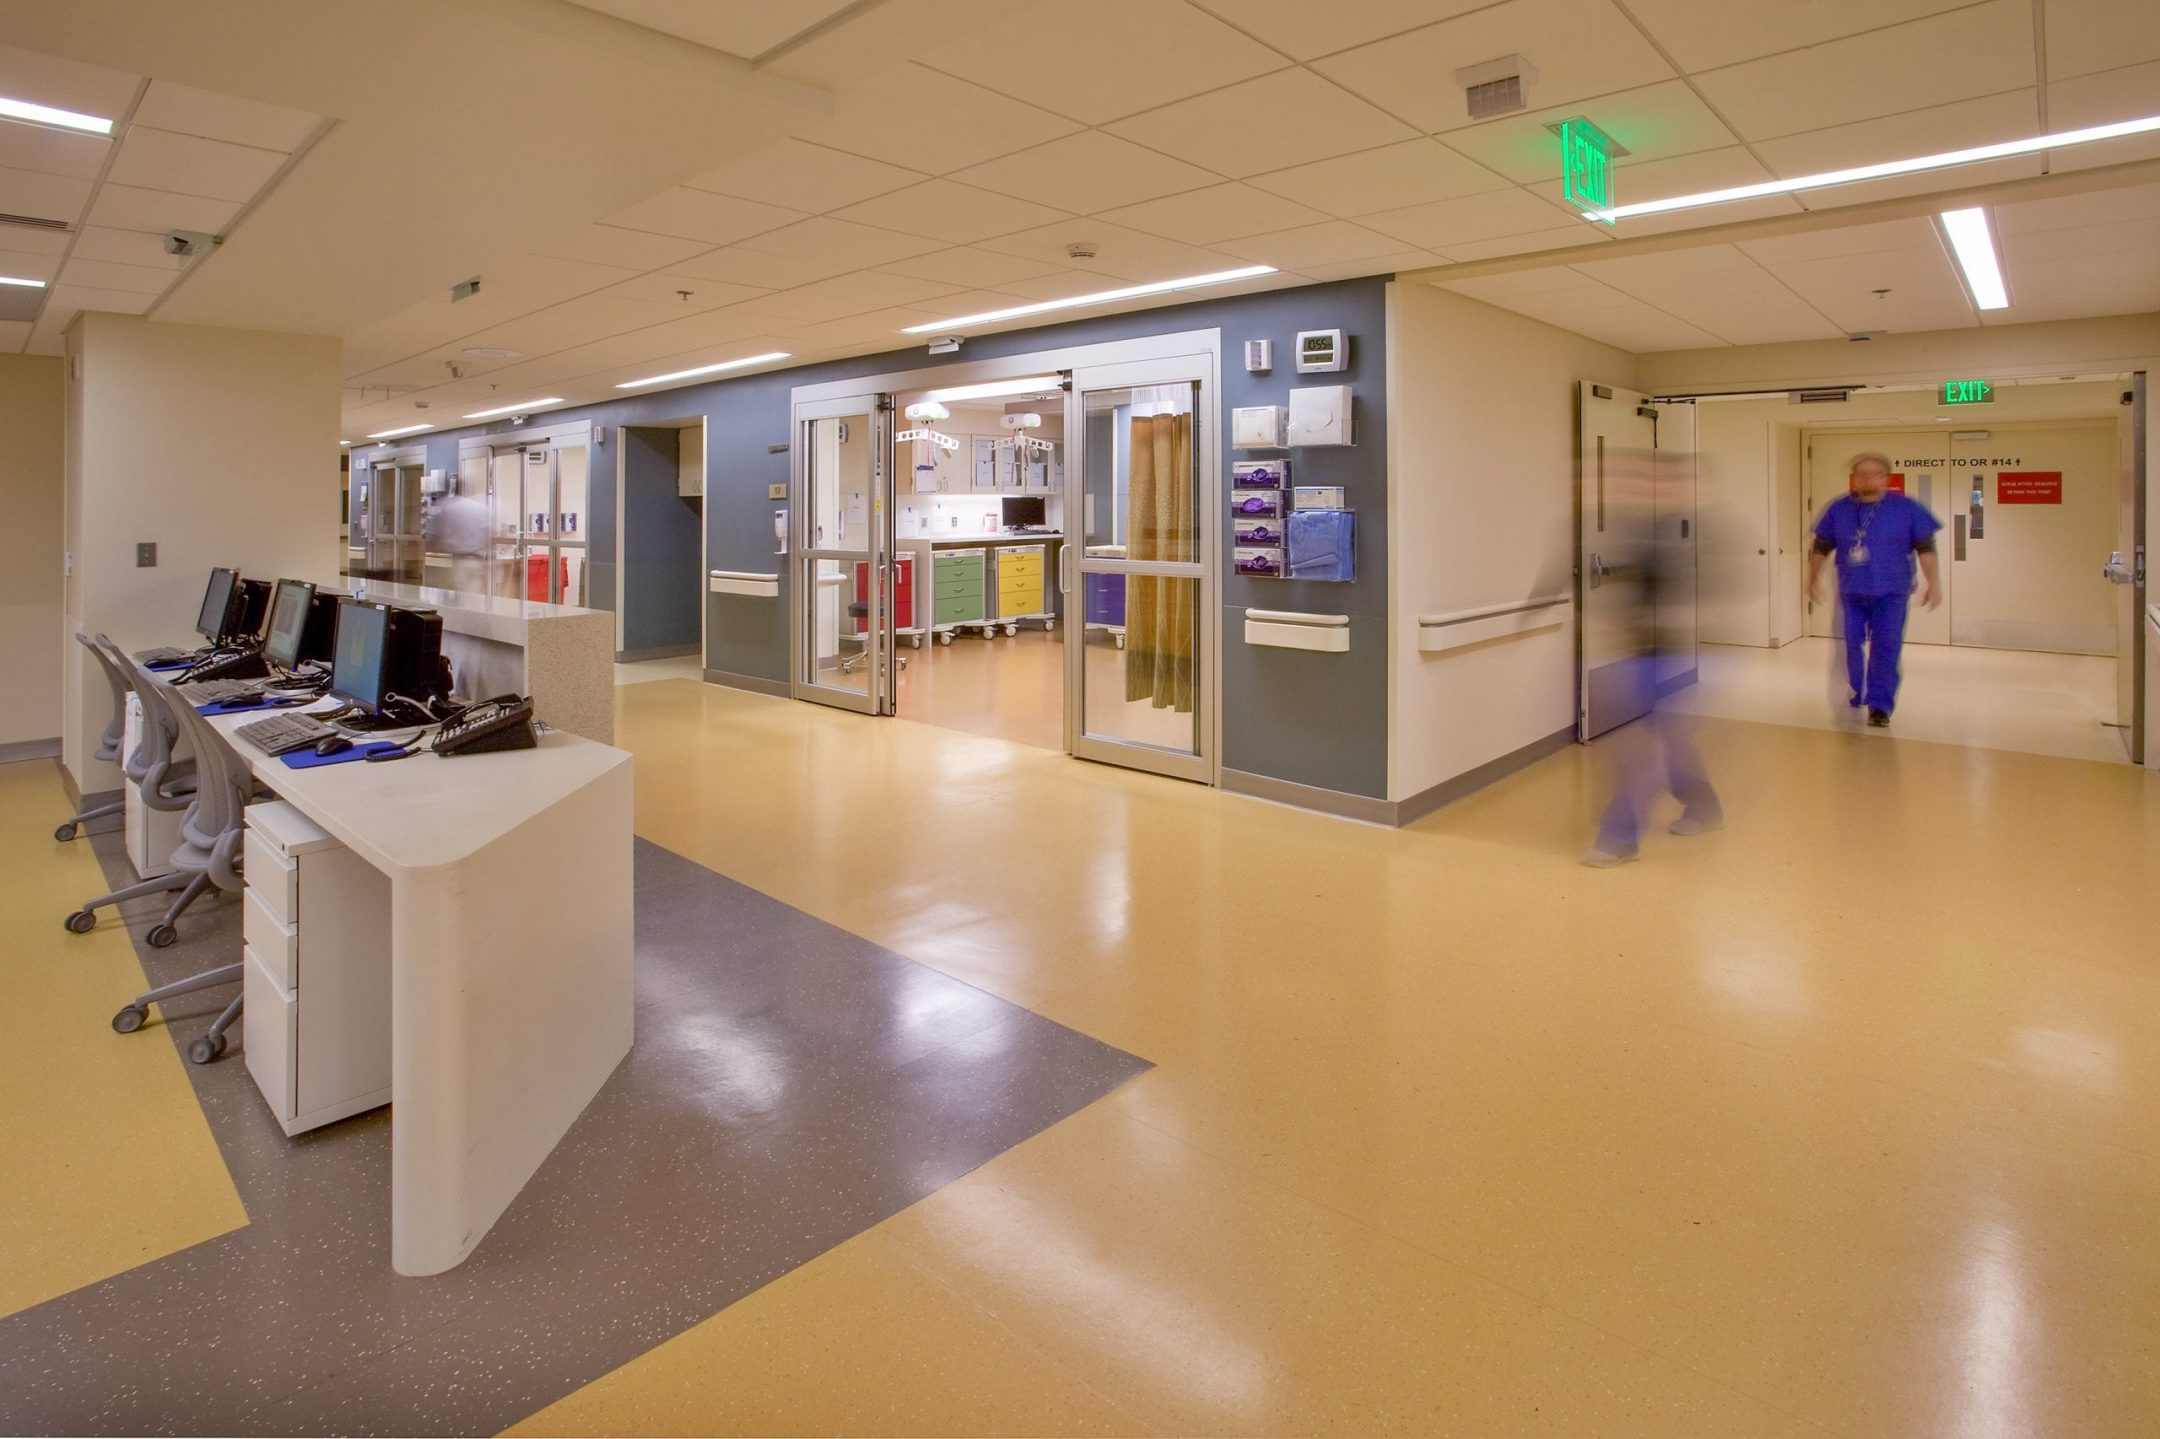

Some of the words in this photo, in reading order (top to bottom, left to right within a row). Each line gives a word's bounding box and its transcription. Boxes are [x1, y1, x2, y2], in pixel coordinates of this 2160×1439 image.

[1575, 134, 1606, 209] EXIT
[1946, 380, 1985, 402] EXIT
[1904, 459, 1946, 468] DIRECT
[1950, 458, 1967, 467] TO
[1970, 458, 1988, 467] OR
[1991, 458, 2012, 467] #14
